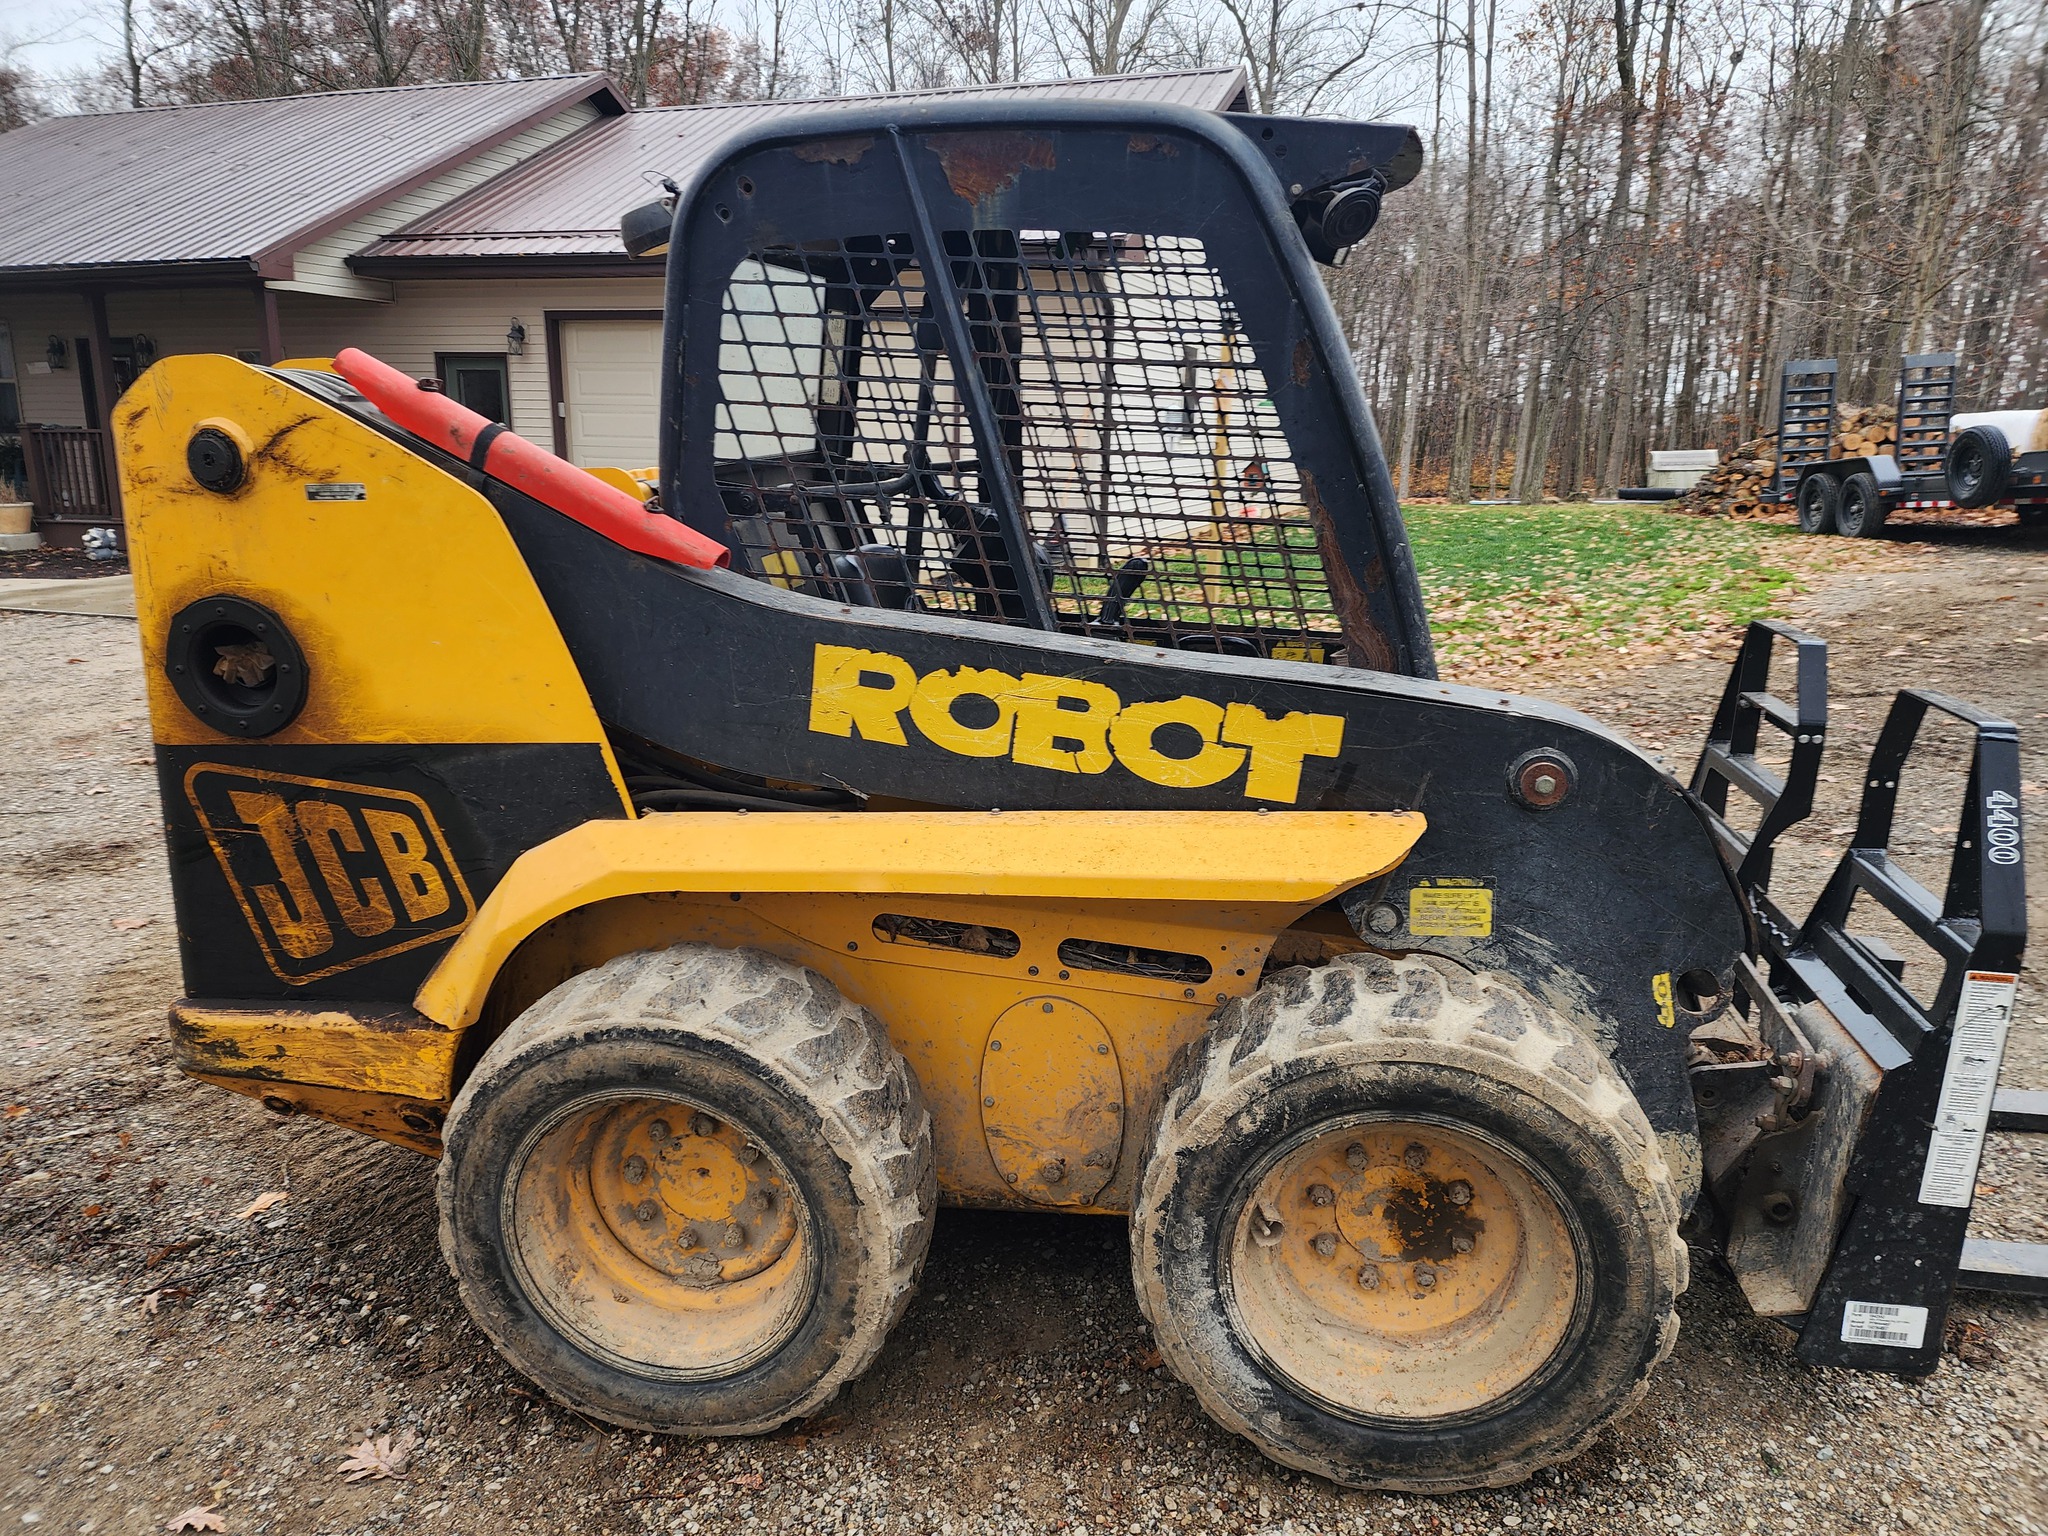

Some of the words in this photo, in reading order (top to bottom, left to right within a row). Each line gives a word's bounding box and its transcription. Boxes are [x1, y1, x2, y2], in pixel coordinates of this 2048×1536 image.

[808, 642, 1345, 804] ROBOT
[228, 790, 450, 959] JCB
[1986, 790, 2020, 865] 4400
